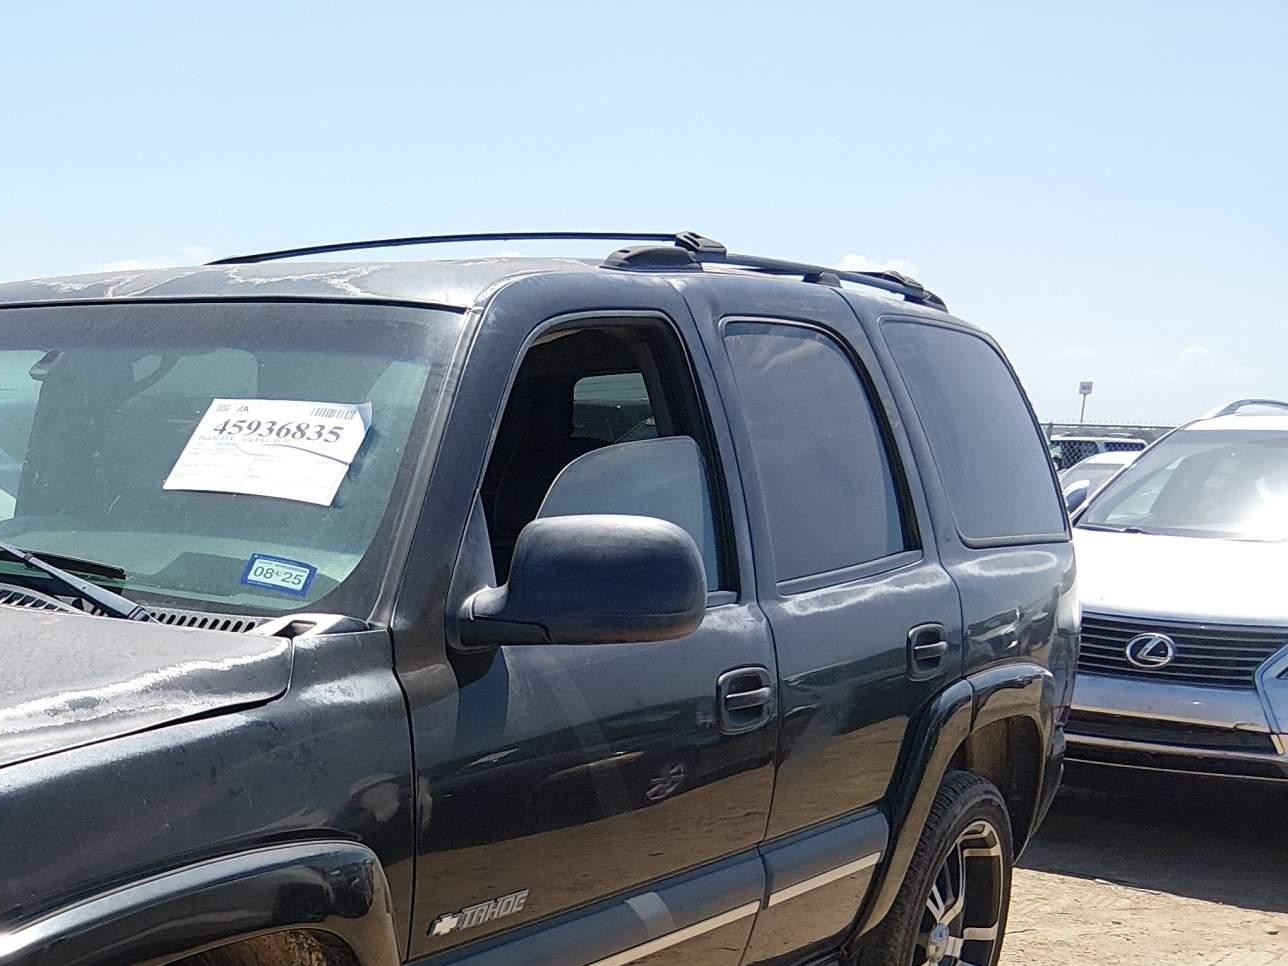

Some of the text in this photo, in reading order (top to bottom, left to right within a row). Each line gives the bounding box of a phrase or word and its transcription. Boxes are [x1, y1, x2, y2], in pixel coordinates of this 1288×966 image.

[213, 418, 344, 444] 45936835
[253, 566, 304, 586] 08 25
[458, 888, 530, 931] TAHOE
